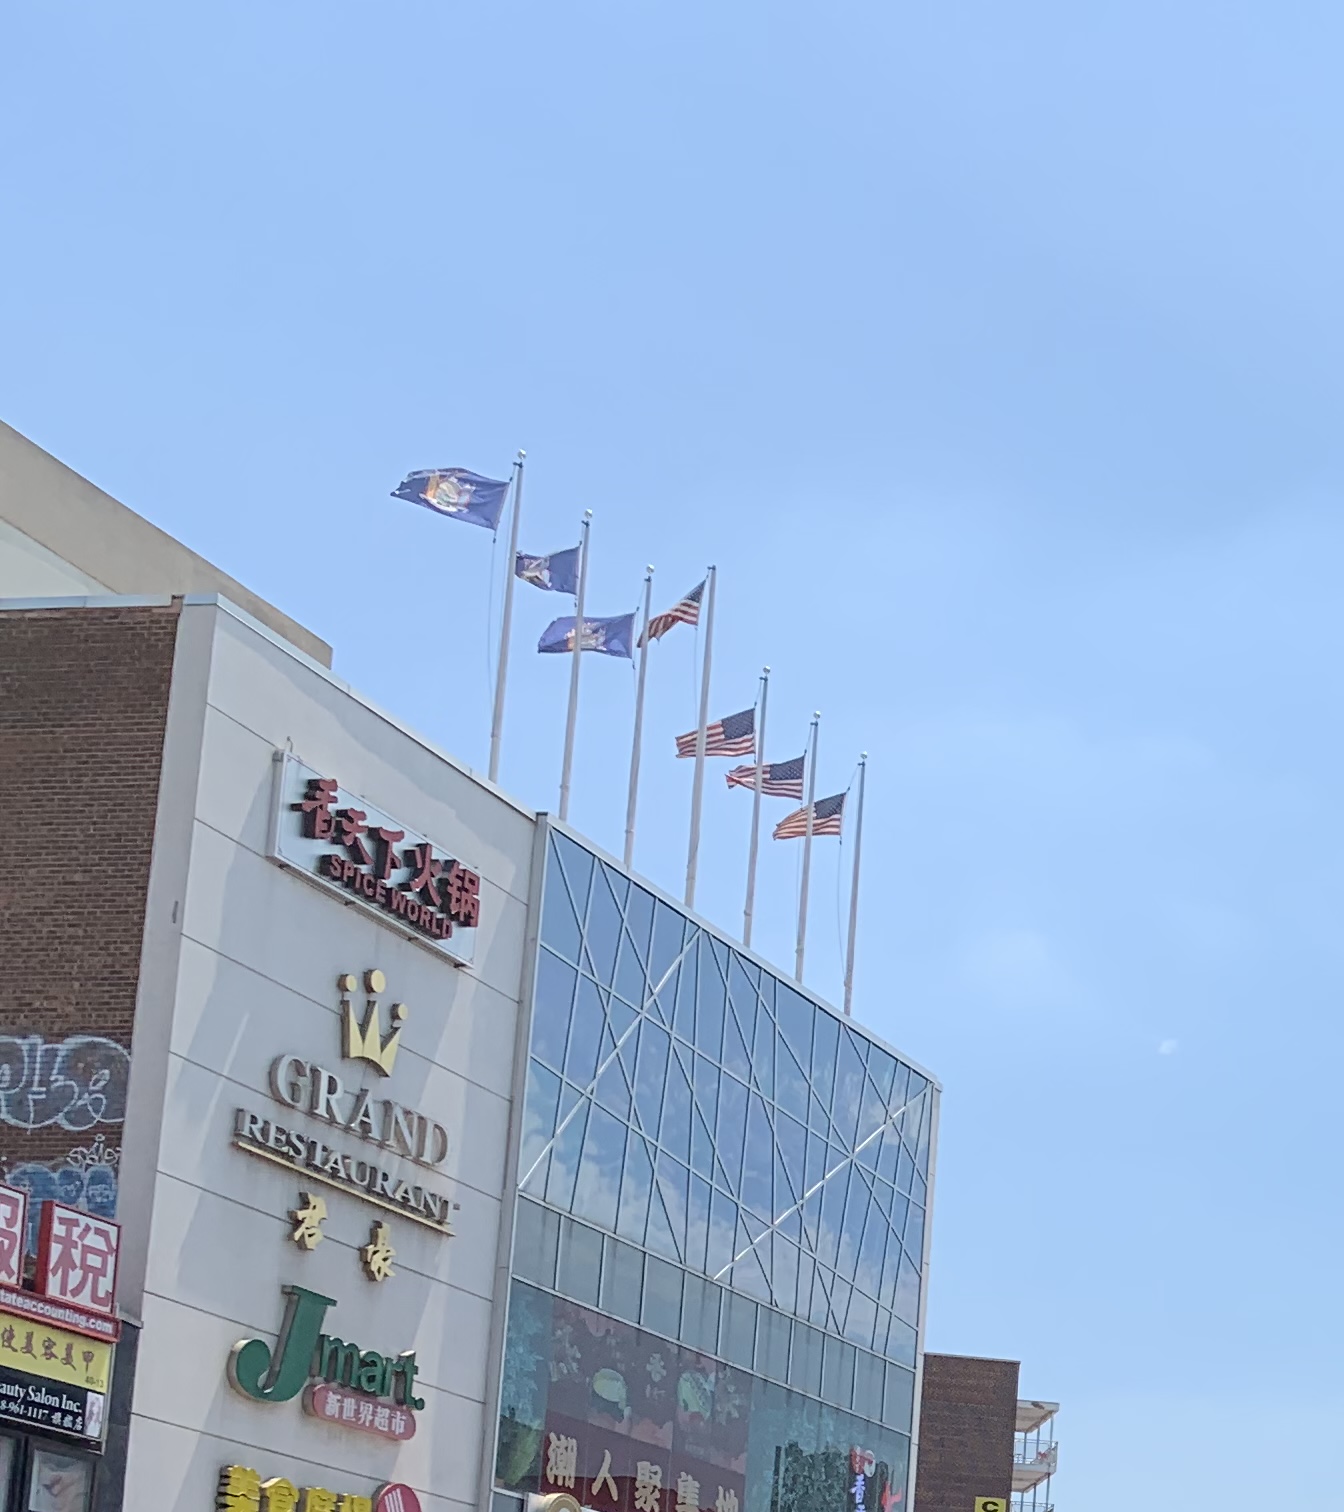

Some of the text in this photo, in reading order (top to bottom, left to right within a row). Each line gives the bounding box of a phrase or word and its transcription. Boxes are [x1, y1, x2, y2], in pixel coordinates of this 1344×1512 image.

[328, 852, 453, 941] SPICE WORLD
[269, 1054, 449, 1167] GRAND
[234, 1107, 460, 1226] RESTAURANT
[0, 1379, 28, 1405] auty
[27, 1384, 60, 1407] Salon
